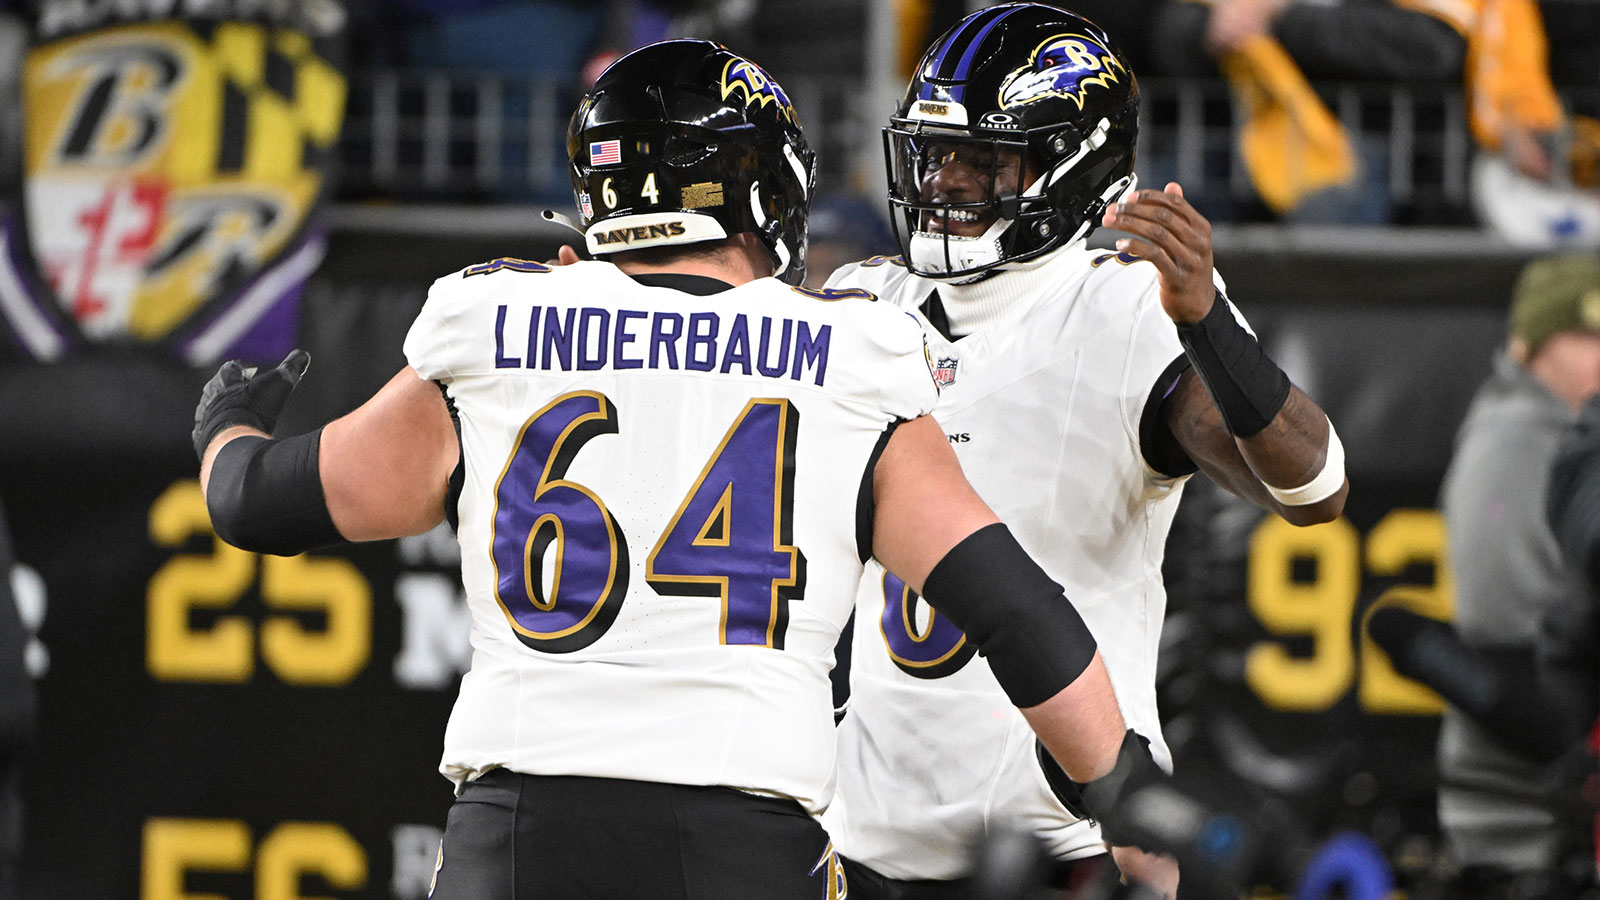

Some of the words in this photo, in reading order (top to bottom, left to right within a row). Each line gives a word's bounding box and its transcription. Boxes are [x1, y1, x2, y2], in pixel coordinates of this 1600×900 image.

[918, 102, 950, 116] RAVENS
[593, 221, 686, 246] RAVENS
[495, 304, 832, 387] LINDERBAUM
[936, 369, 954, 382] NFL
[490, 389, 808, 654] 64
[146, 481, 372, 686] 25
[1245, 508, 1458, 714] 92
